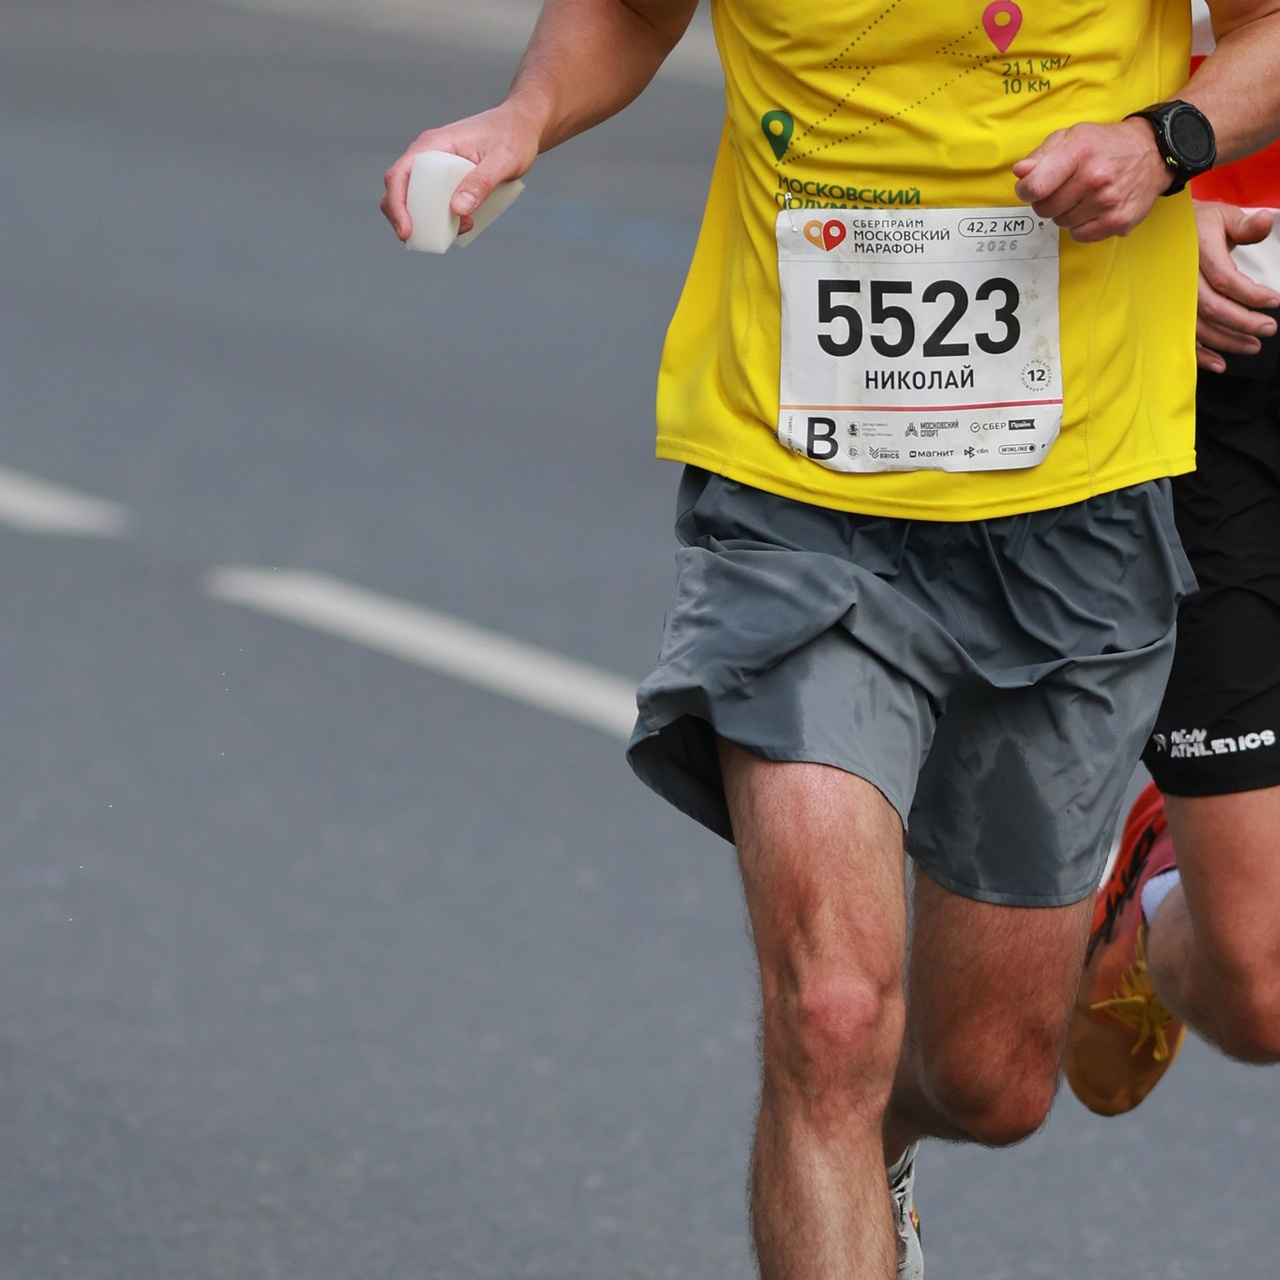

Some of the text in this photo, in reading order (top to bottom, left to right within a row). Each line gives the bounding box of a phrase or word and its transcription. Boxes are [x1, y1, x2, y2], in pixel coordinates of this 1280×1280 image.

[1002, 58, 1034, 77] 21.1
[1002, 79, 1051, 94] 10 КМ
[778, 174, 921, 205] МОСКОВСКИЙ
[853, 219, 924, 228] СБЕРПРАЙМ
[966, 220, 1025, 234] 42,2 КМ
[854, 228, 950, 242] МОСКОВСКИЙ
[854, 242, 925, 254] МАРАФОН
[817, 278, 1021, 358] 5523
[865, 365, 974, 390] НИКОЛАЙ
[1027, 369, 1046, 382] 12
[920, 420, 959, 429] МОСКОВСКИЙ
[982, 422, 1007, 430] СБЕР
[806, 417, 839, 461] B
